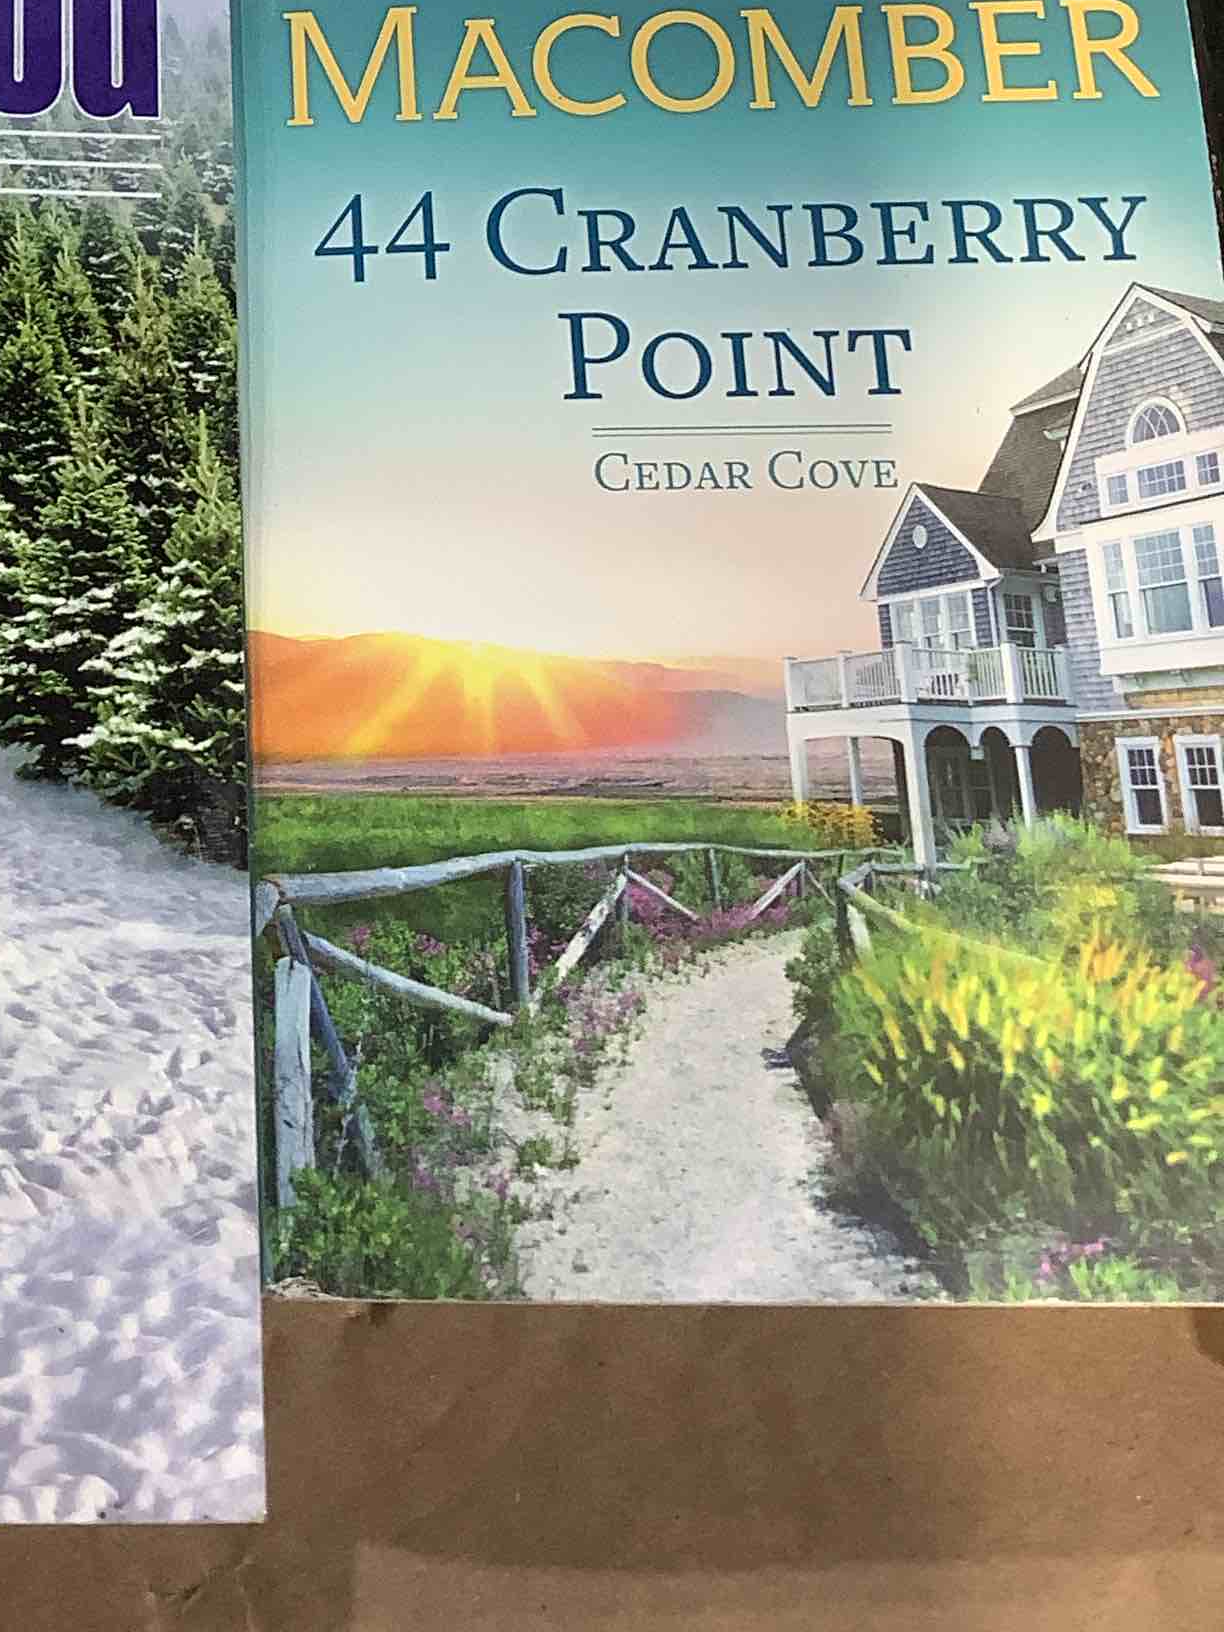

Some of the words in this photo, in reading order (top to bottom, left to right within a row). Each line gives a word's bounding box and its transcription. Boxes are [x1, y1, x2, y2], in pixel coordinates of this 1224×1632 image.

[314, 190, 451, 283] 44
[485, 186, 1149, 277] CRANBERRY
[557, 310, 913, 402] POINT
[594, 452, 753, 491] CEDAR
[767, 449, 900, 489] COVE
